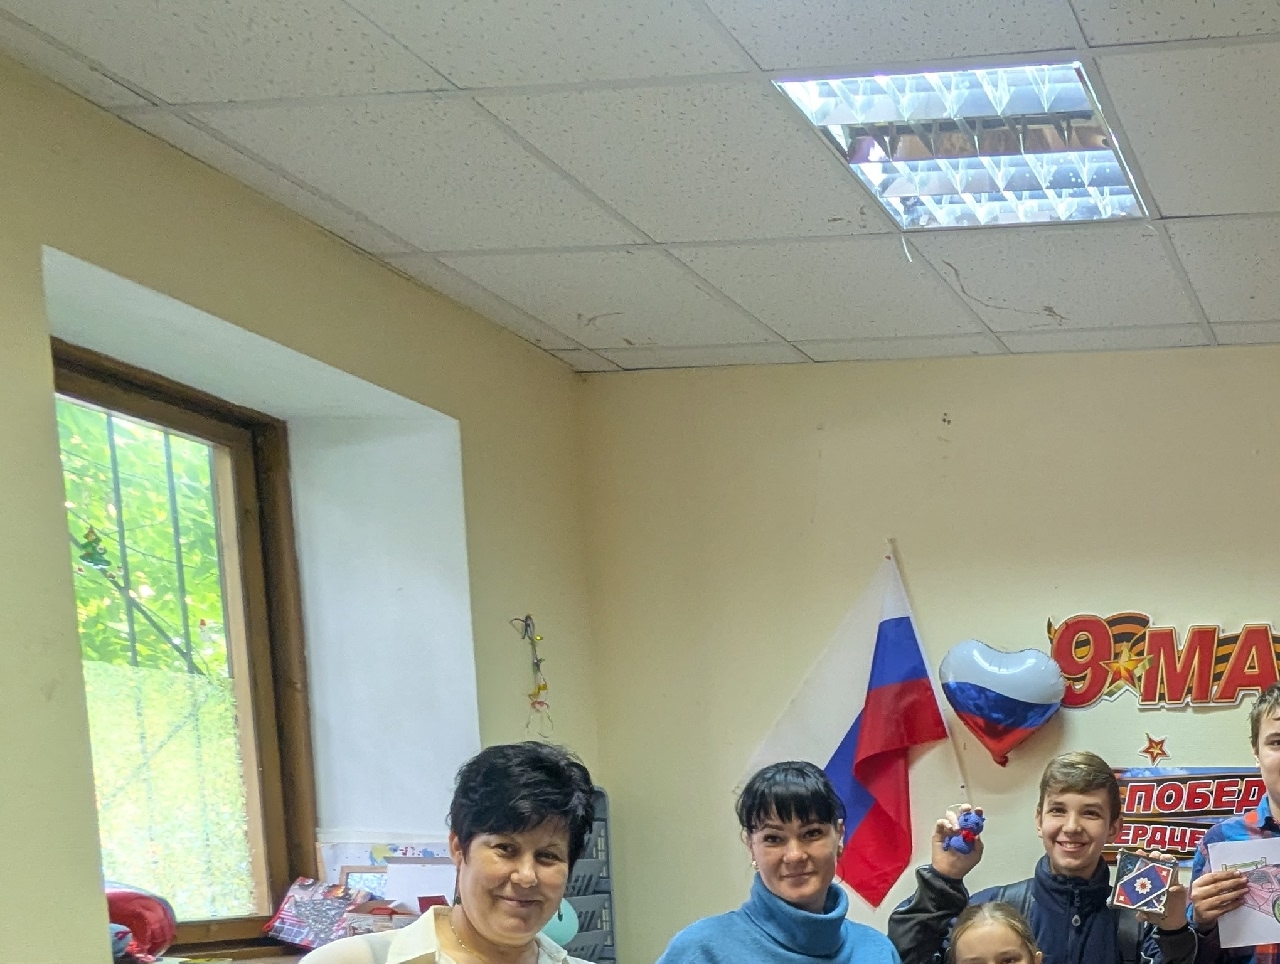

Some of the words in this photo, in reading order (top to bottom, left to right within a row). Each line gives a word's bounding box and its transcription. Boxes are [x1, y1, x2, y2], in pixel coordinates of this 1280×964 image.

[1052, 614, 1115, 708] 9
[1124, 778, 1267, 814] ПОБЕД
[1104, 824, 1207, 852] ЕРДЦЕ
